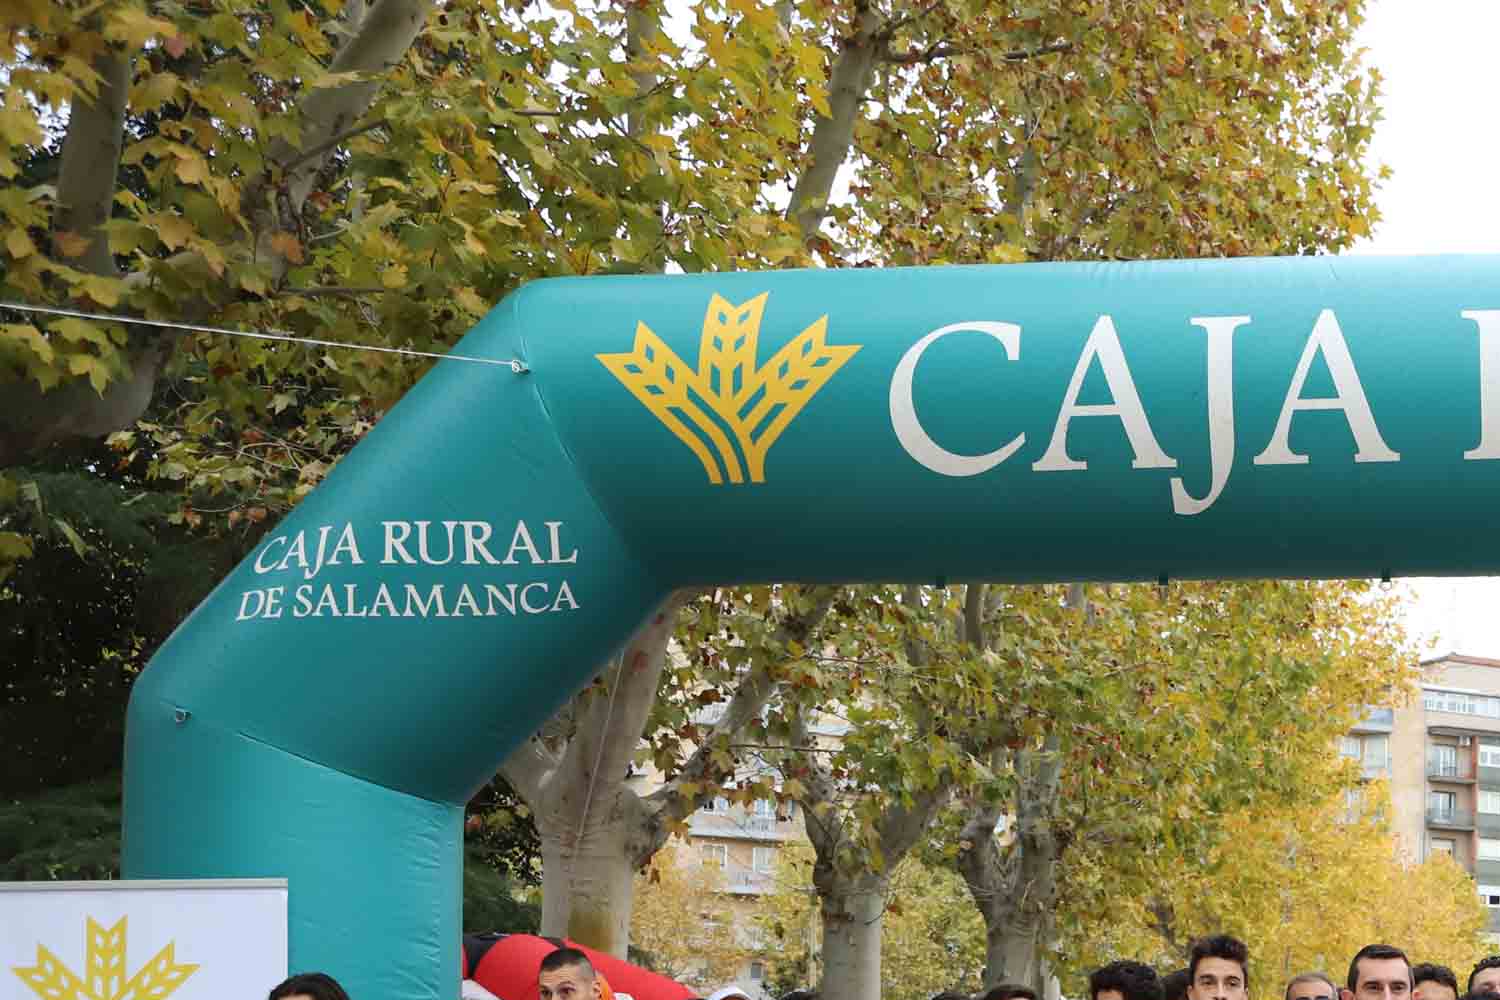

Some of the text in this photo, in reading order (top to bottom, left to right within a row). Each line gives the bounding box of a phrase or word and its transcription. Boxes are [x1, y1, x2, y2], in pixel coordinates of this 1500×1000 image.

[889, 308, 1401, 516] CAJA
[254, 519, 579, 579] CAJA RURAL
[236, 580, 581, 622] DE SALAMANCA
